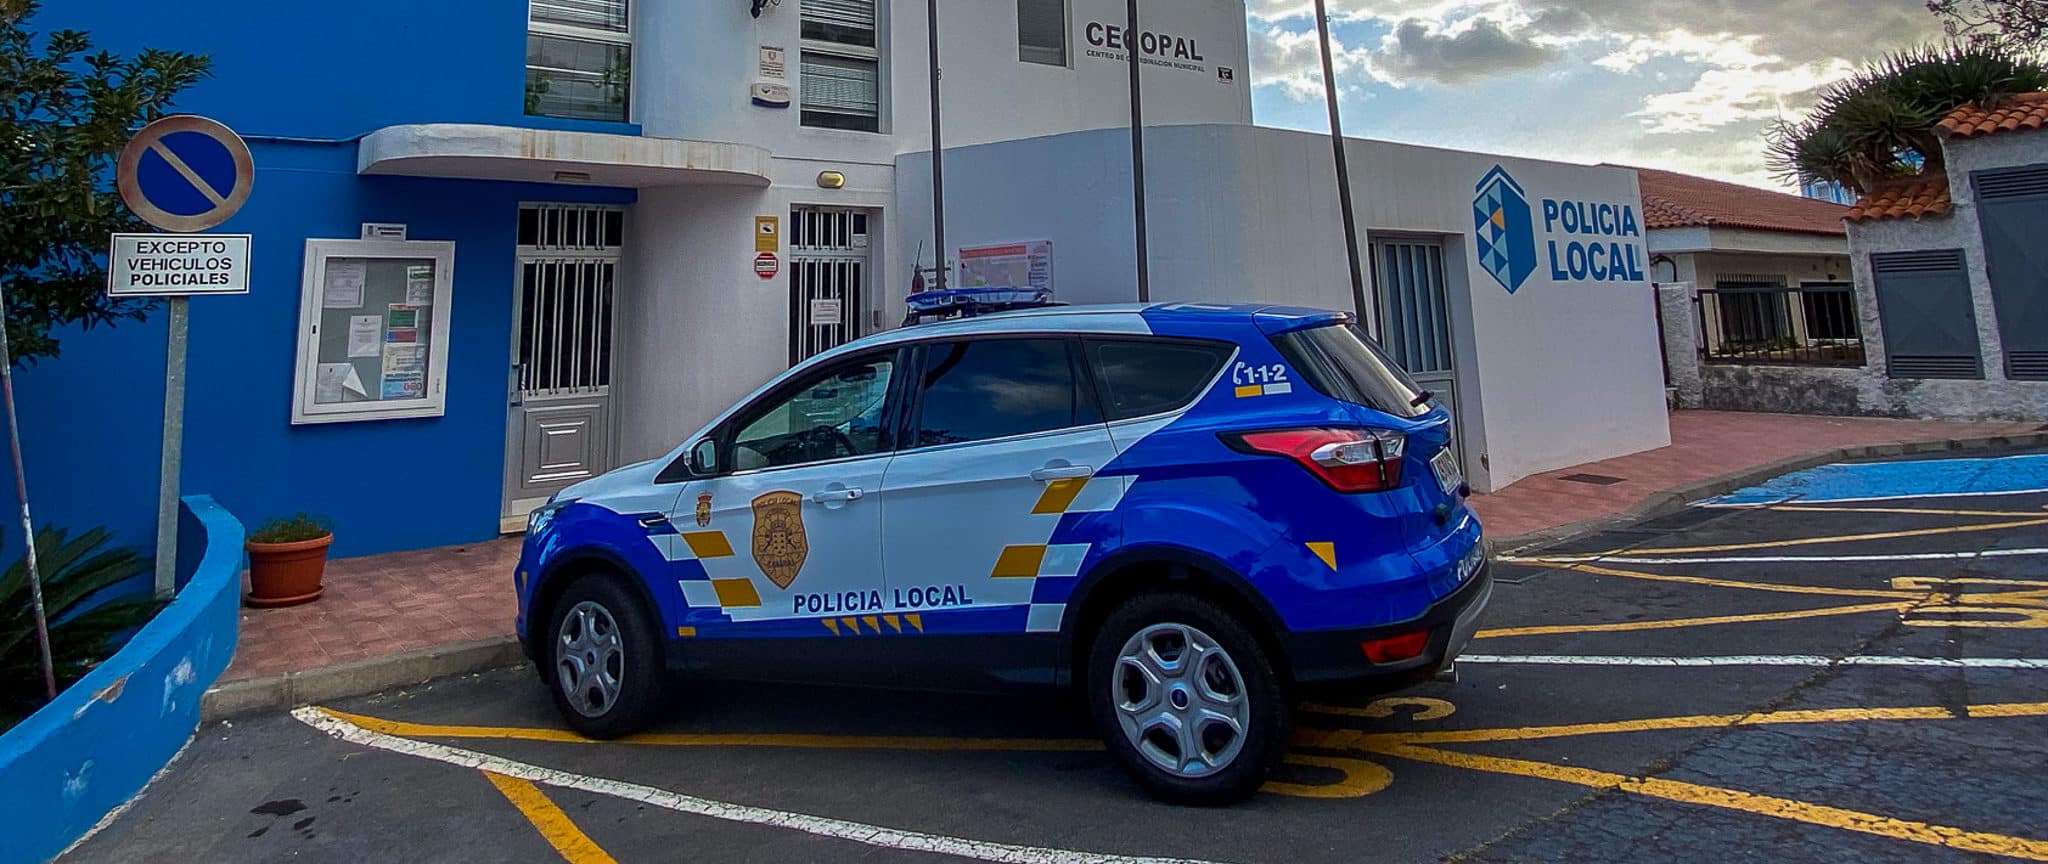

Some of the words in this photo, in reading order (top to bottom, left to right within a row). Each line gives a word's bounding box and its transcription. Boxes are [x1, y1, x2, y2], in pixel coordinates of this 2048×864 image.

[1126, 54, 1173, 68] CRDINACION
[1542, 199, 1639, 237] POLICIA
[136, 241, 226, 254] EXCEPTO
[127, 257, 232, 271] VEHICULOS
[1547, 240, 1644, 281] LOCAL
[130, 273, 229, 286] POLICIALES
[793, 590, 883, 613] POLICIA
[894, 585, 973, 608] LOCAL
